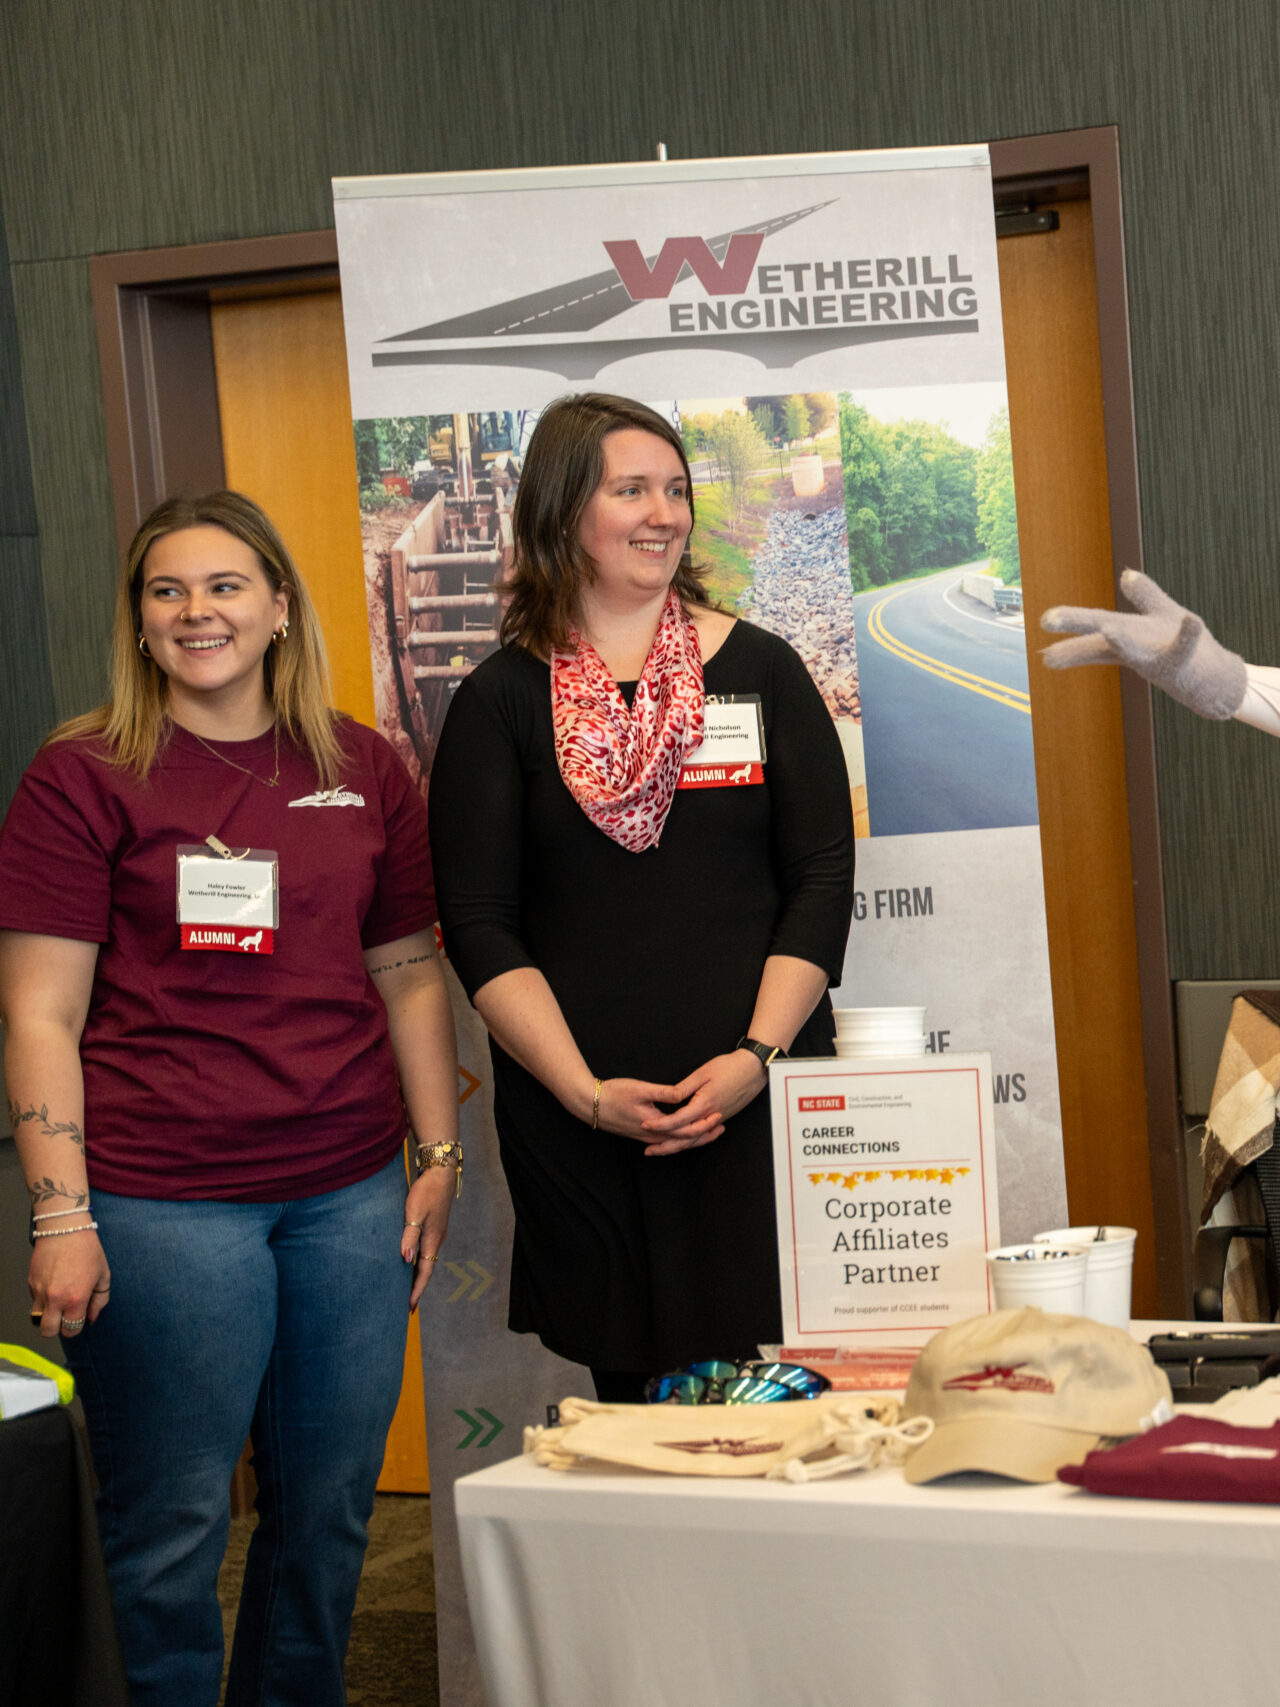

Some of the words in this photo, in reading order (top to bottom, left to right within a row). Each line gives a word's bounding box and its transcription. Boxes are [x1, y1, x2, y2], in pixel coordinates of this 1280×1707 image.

[601, 233, 974, 300] WETHERILL
[668, 289, 979, 333] ENGINEERING
[710, 732, 749, 741] Engineering
[683, 769, 726, 783] ALUMNI
[874, 886, 934, 919] FIRM
[189, 931, 236, 945] ALUMNI
[802, 1100, 815, 1110] NC
[816, 1099, 841, 1109] STATE
[802, 1126, 855, 1139] CAREER
[802, 1141, 900, 1156] CONNECTIONS
[825, 1196, 952, 1223] Corporate
[833, 1228, 949, 1252] Affiliates
[843, 1264, 940, 1285] Partner
[834, 1305, 855, 1315] Proud
[856, 1305, 889, 1315] supporter
[890, 1304, 898, 1313] of
[899, 1304, 918, 1312] CCEE
[919, 1302, 950, 1312] students
